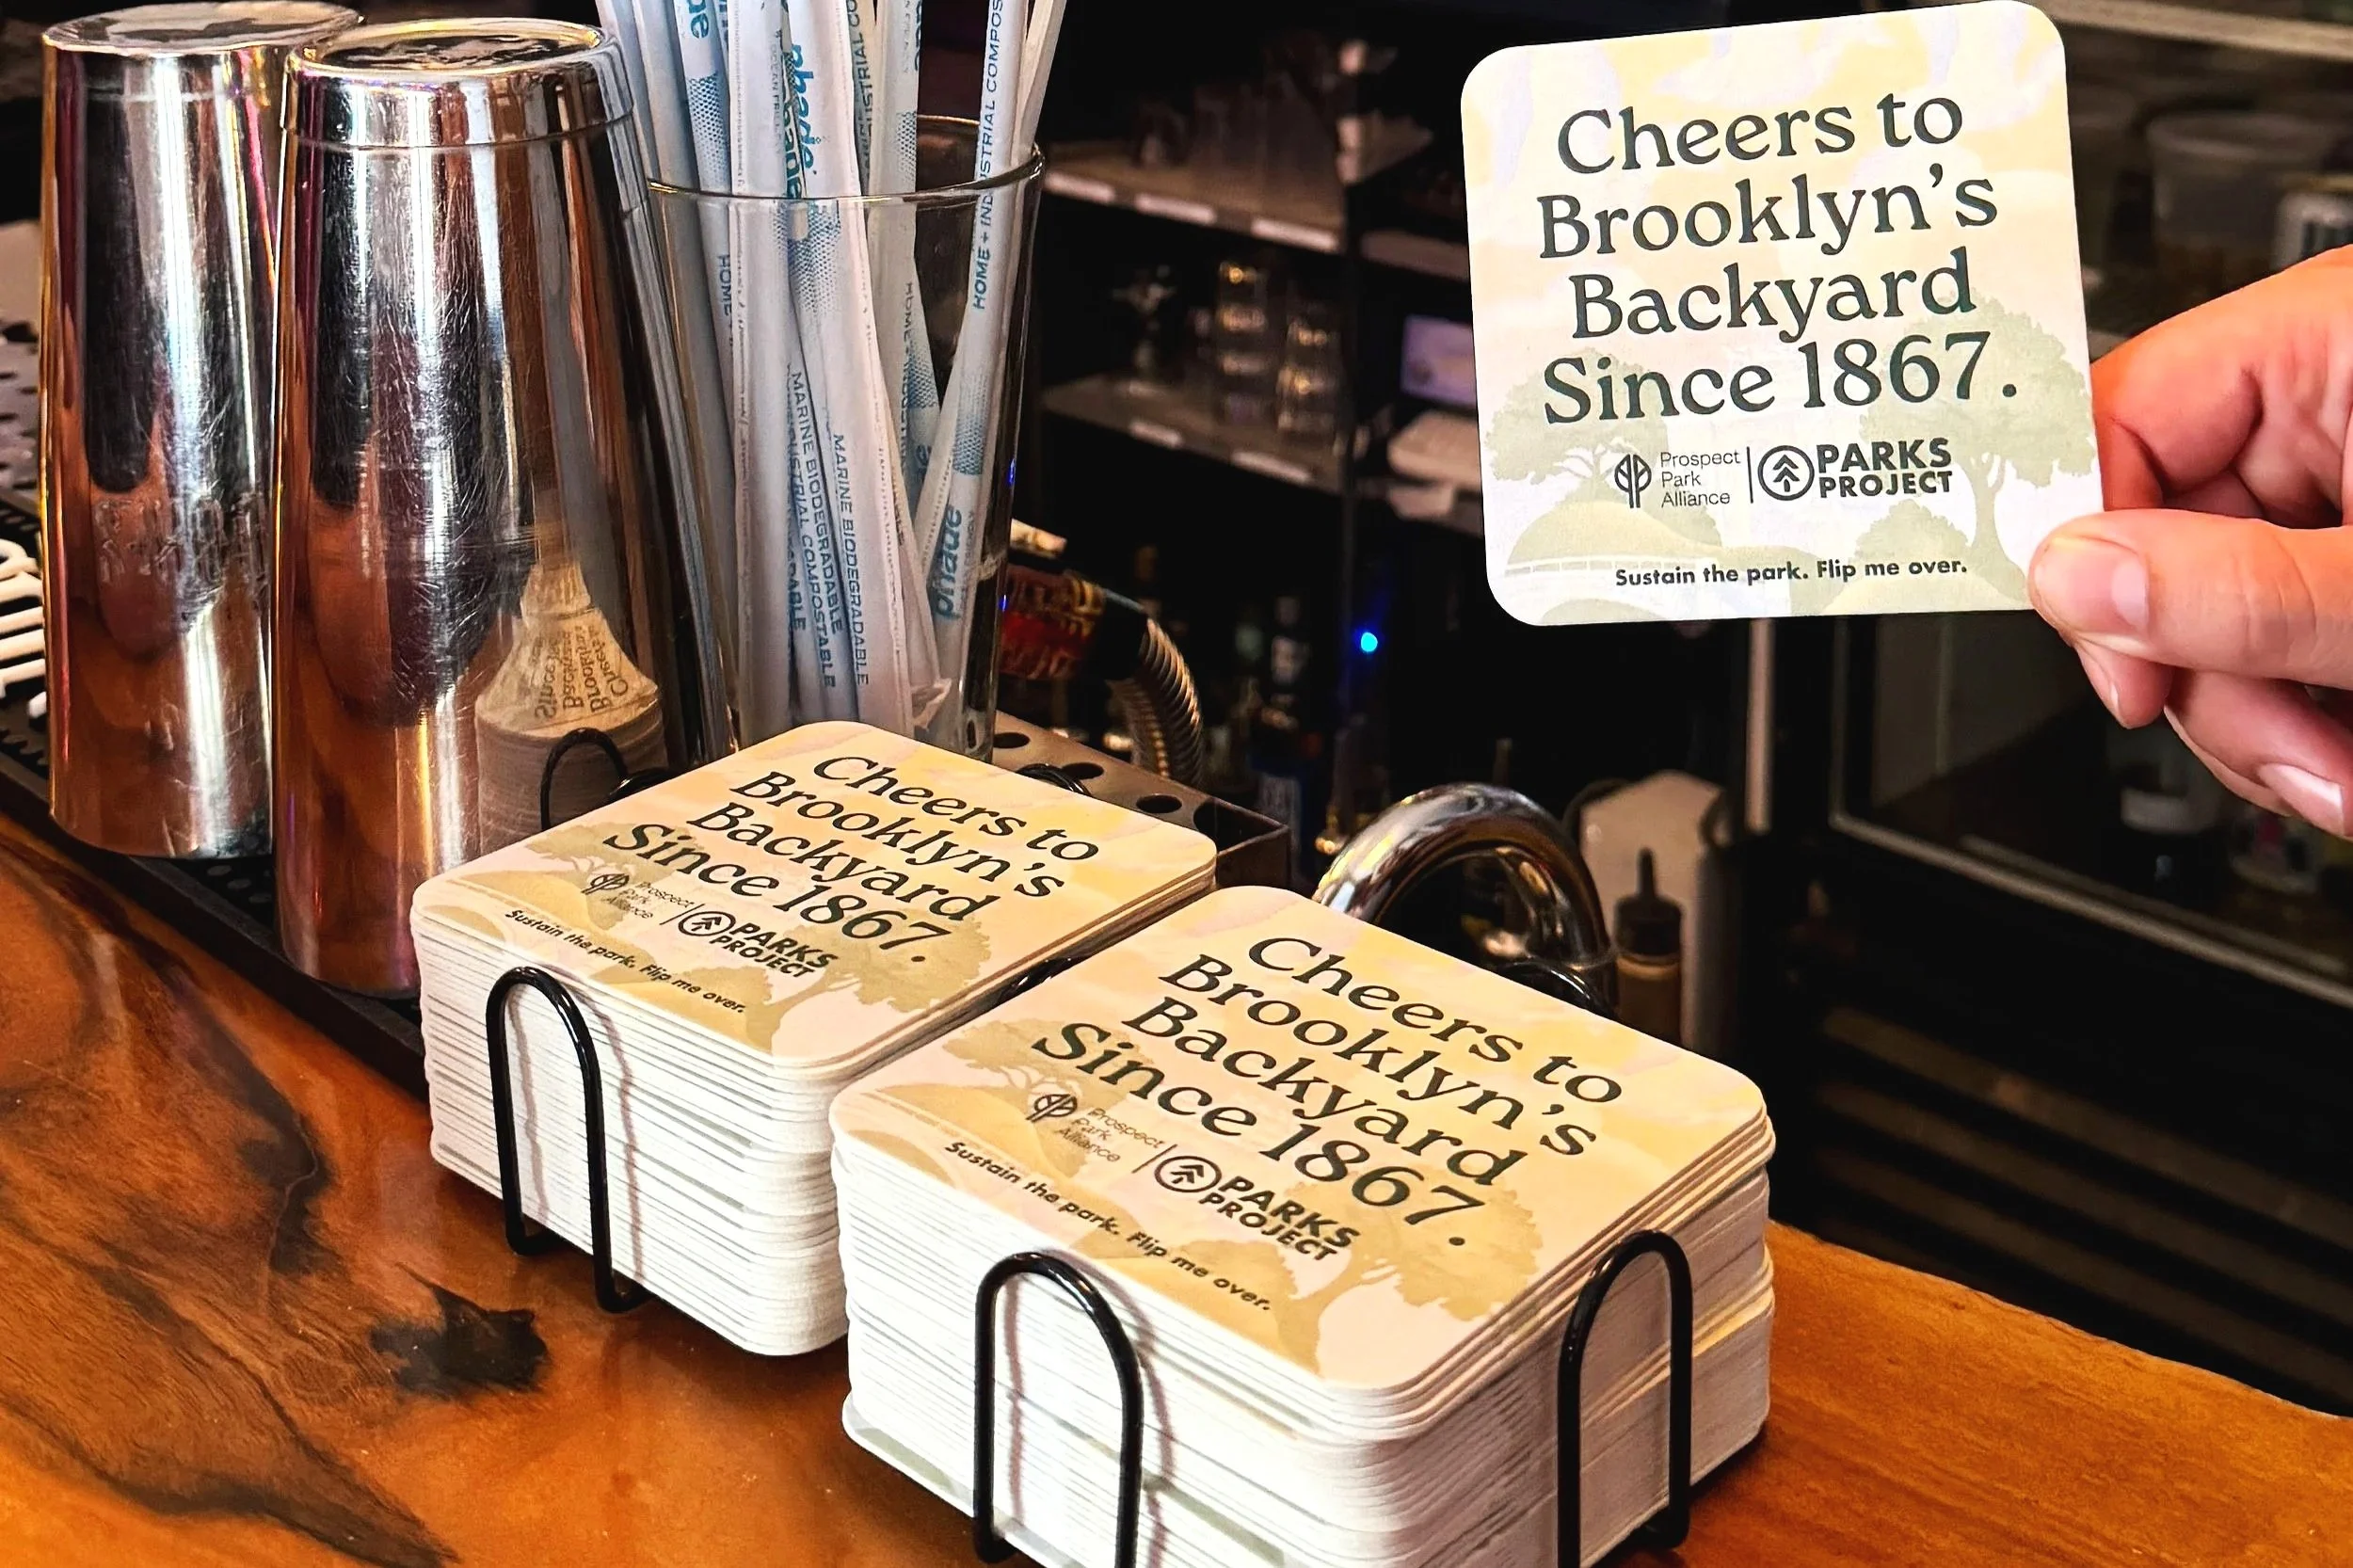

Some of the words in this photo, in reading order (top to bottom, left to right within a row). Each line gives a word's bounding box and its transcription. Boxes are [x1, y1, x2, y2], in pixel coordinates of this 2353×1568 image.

[980, 100, 996, 226] INDSTRIAL
[1558, 101, 1855, 174] Cheers
[1877, 93, 1963, 148] to
[1536, 163, 1998, 259] Brooklyn's
[973, 247, 991, 310] HOME
[1568, 246, 1977, 343] Backyard
[1543, 356, 1775, 425] Since
[1798, 330, 2017, 408] 1867.
[833, 434, 853, 514] MARINE
[1660, 451, 1741, 469] Prospect
[1660, 471, 1702, 488] Park
[1660, 490, 1731, 508] Alliance
[1817, 438, 1952, 472] PARKS
[1818, 471, 1953, 498] PROJECT
[792, 372, 813, 456] MARINE
[806, 457, 843, 635] BIODEGRADABLE
[801, 534, 836, 688] COMPOSTABLE
[842, 518, 869, 686] BIODEGRADABLE
[1615, 567, 1695, 586] Sustain
[1702, 564, 1738, 583] the
[1747, 567, 1809, 586] park.
[1817, 560, 1856, 582] Flip
[1865, 564, 1900, 576] me
[1909, 559, 1967, 574] over.
[728, 771, 1065, 898] Brooklyn's
[813, 757, 1027, 836] Cheers
[1026, 829, 1099, 860] to
[602, 824, 780, 897] Since
[773, 885, 952, 962] 1867.
[686, 802, 1001, 920] Backyard
[504, 909, 564, 937] Sustain
[563, 934, 591, 950] the
[587, 943, 636, 968] park.
[639, 963, 672, 984] Flip
[671, 977, 701, 995] me
[702, 990, 746, 1014] over.
[709, 935, 815, 978] PROJECT
[728, 922, 839, 968] PARKS
[1158, 953, 1597, 1156] Brooklyn's
[1248, 937, 1524, 1063] Cheers
[1533, 1056, 1622, 1103] to
[1031, 1022, 1257, 1137] Since
[1258, 1123, 1485, 1246] 1867.
[1071, 1117, 1112, 1142] Park
[1087, 1107, 1166, 1149] Prospect
[1121, 996, 1529, 1186] Backyard
[1053, 1128, 1121, 1162] Alliance
[945, 1141, 1021, 1184] Sustain
[1021, 1180, 1060, 1205] the
[1057, 1198, 1120, 1237] park.
[1127, 1231, 1167, 1259] Flip
[1170, 1255, 1209, 1279] me
[1213, 1277, 1272, 1311] over.
[1198, 1192, 1337, 1261] PROJECT
[1217, 1175, 1361, 1249] PARKS
